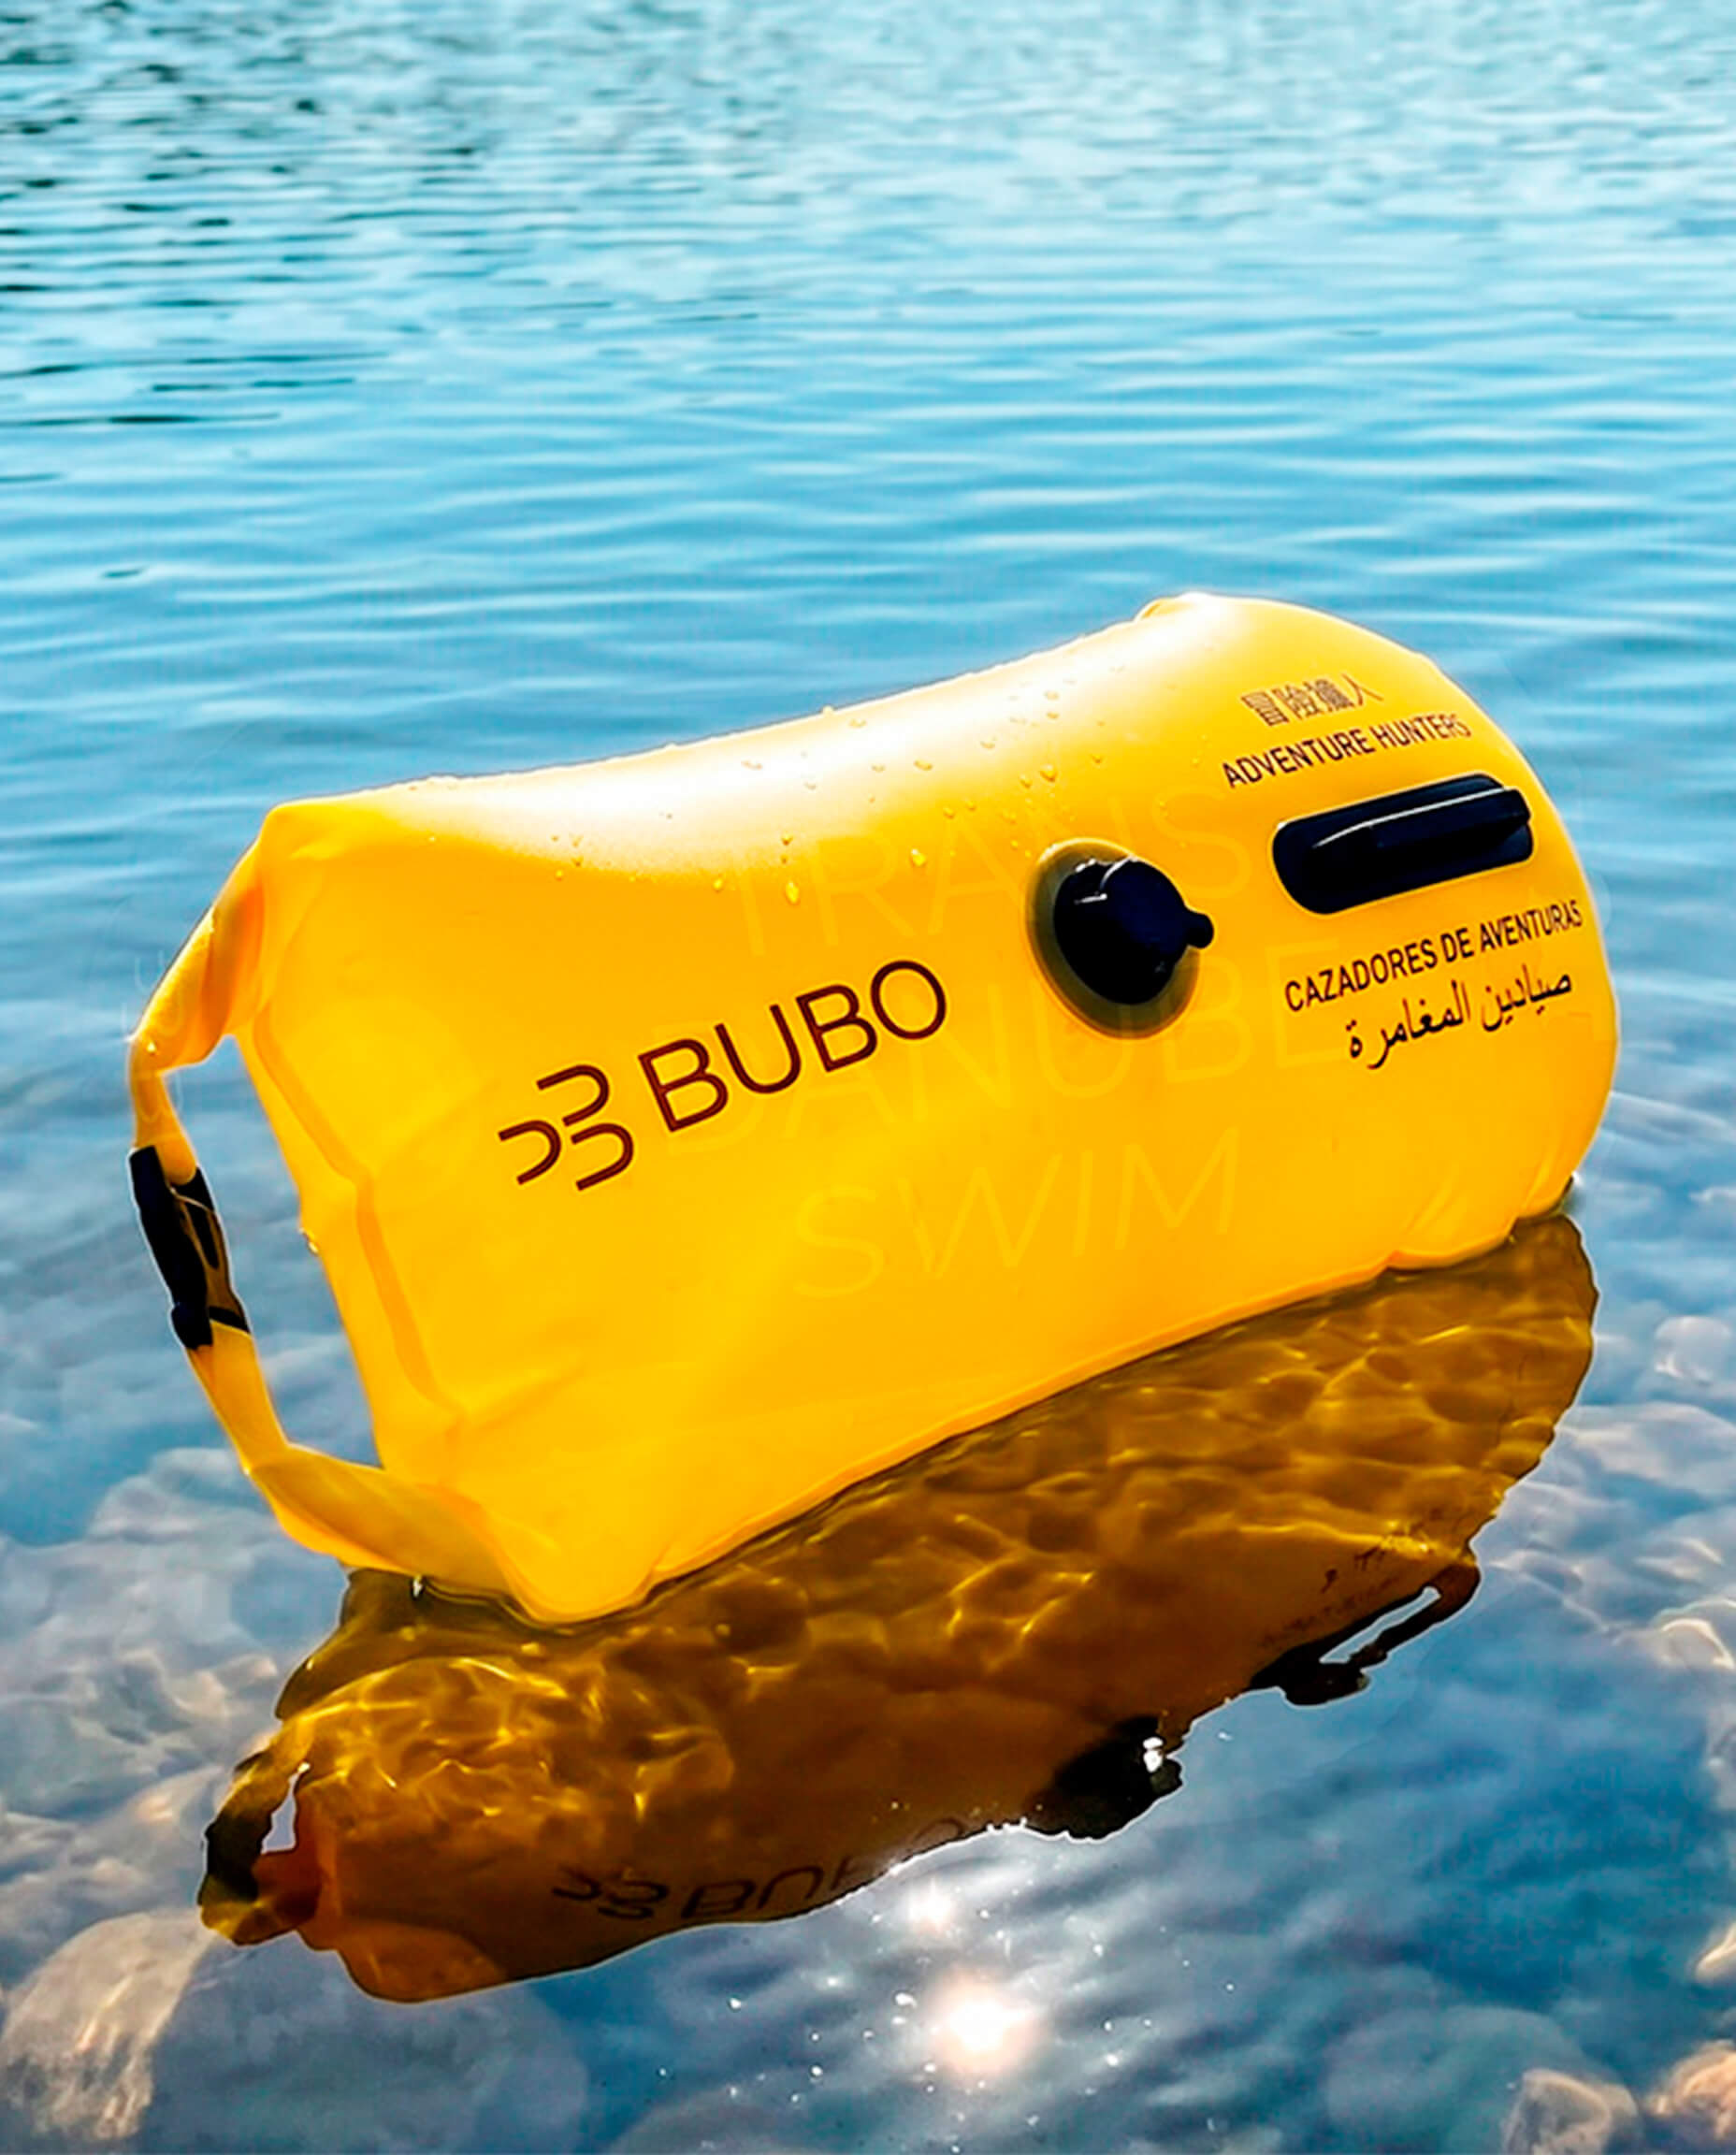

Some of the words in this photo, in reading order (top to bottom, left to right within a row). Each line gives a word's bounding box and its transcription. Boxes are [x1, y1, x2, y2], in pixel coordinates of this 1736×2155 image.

[1221, 728, 1377, 788] ADVENTURE
[1368, 713, 1472, 750] HUNTERS
[1284, 939, 1439, 1012] CAZADORES
[1441, 927, 1475, 963] DE
[1479, 899, 1584, 952] AVENTURAS
[1481, 962, 1572, 1033] صيادين
[638, 960, 947, 1133] BUBO
[1344, 978, 1471, 1070] المغامرة
[793, 1126, 1239, 1298] SWIM
